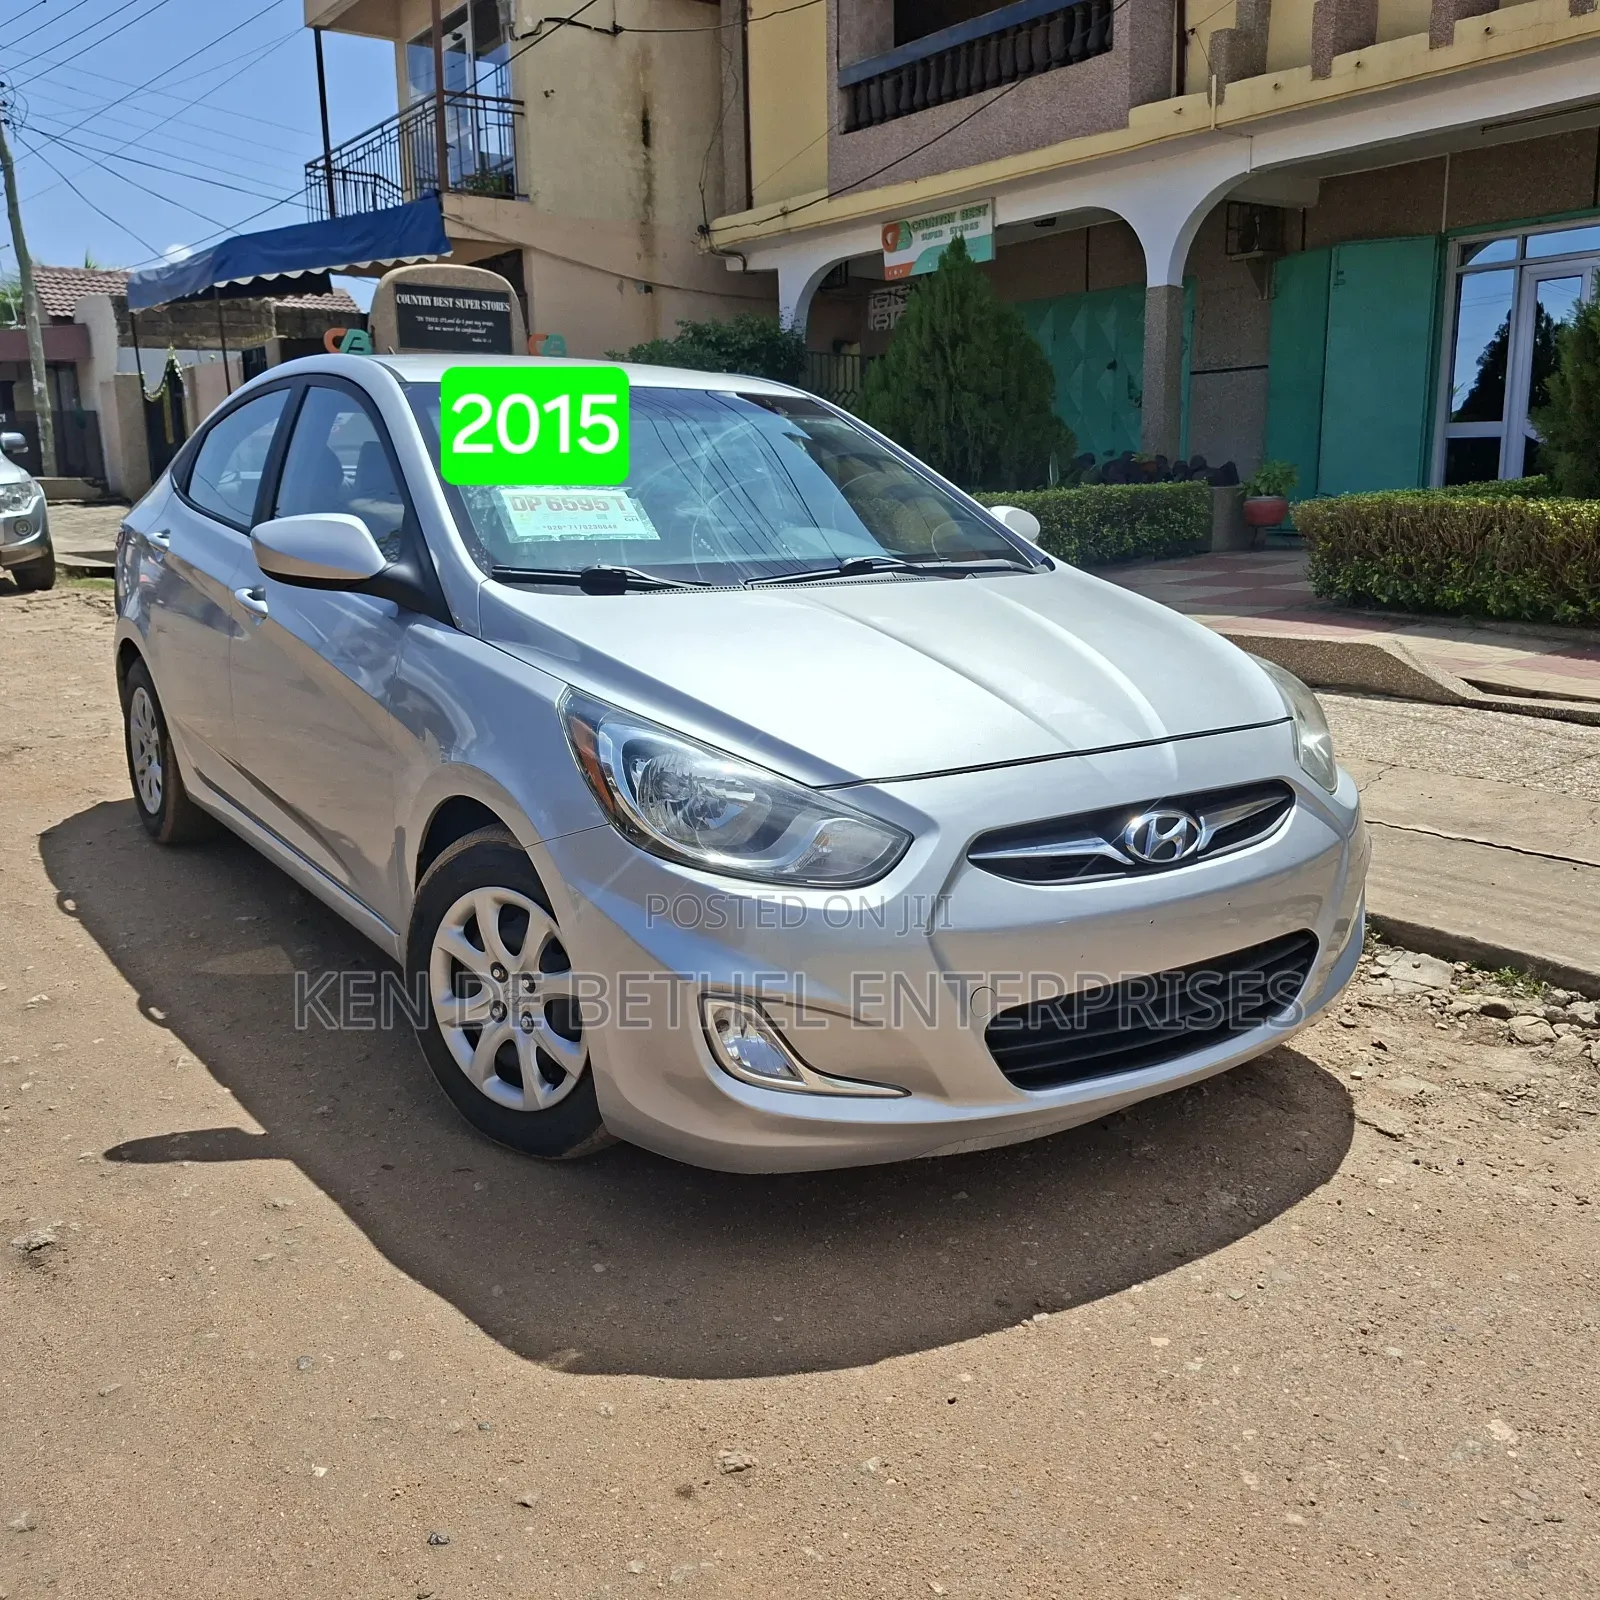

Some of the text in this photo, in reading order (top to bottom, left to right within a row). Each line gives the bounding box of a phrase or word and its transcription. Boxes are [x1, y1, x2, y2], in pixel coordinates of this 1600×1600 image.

[910, 203, 989, 232] COUNTRY BEST
[921, 221, 979, 241] SUPER STORES
[396, 293, 511, 313] COUNTRY BEST SUPER STORES
[509, 496, 627, 512] DP 6595 T
